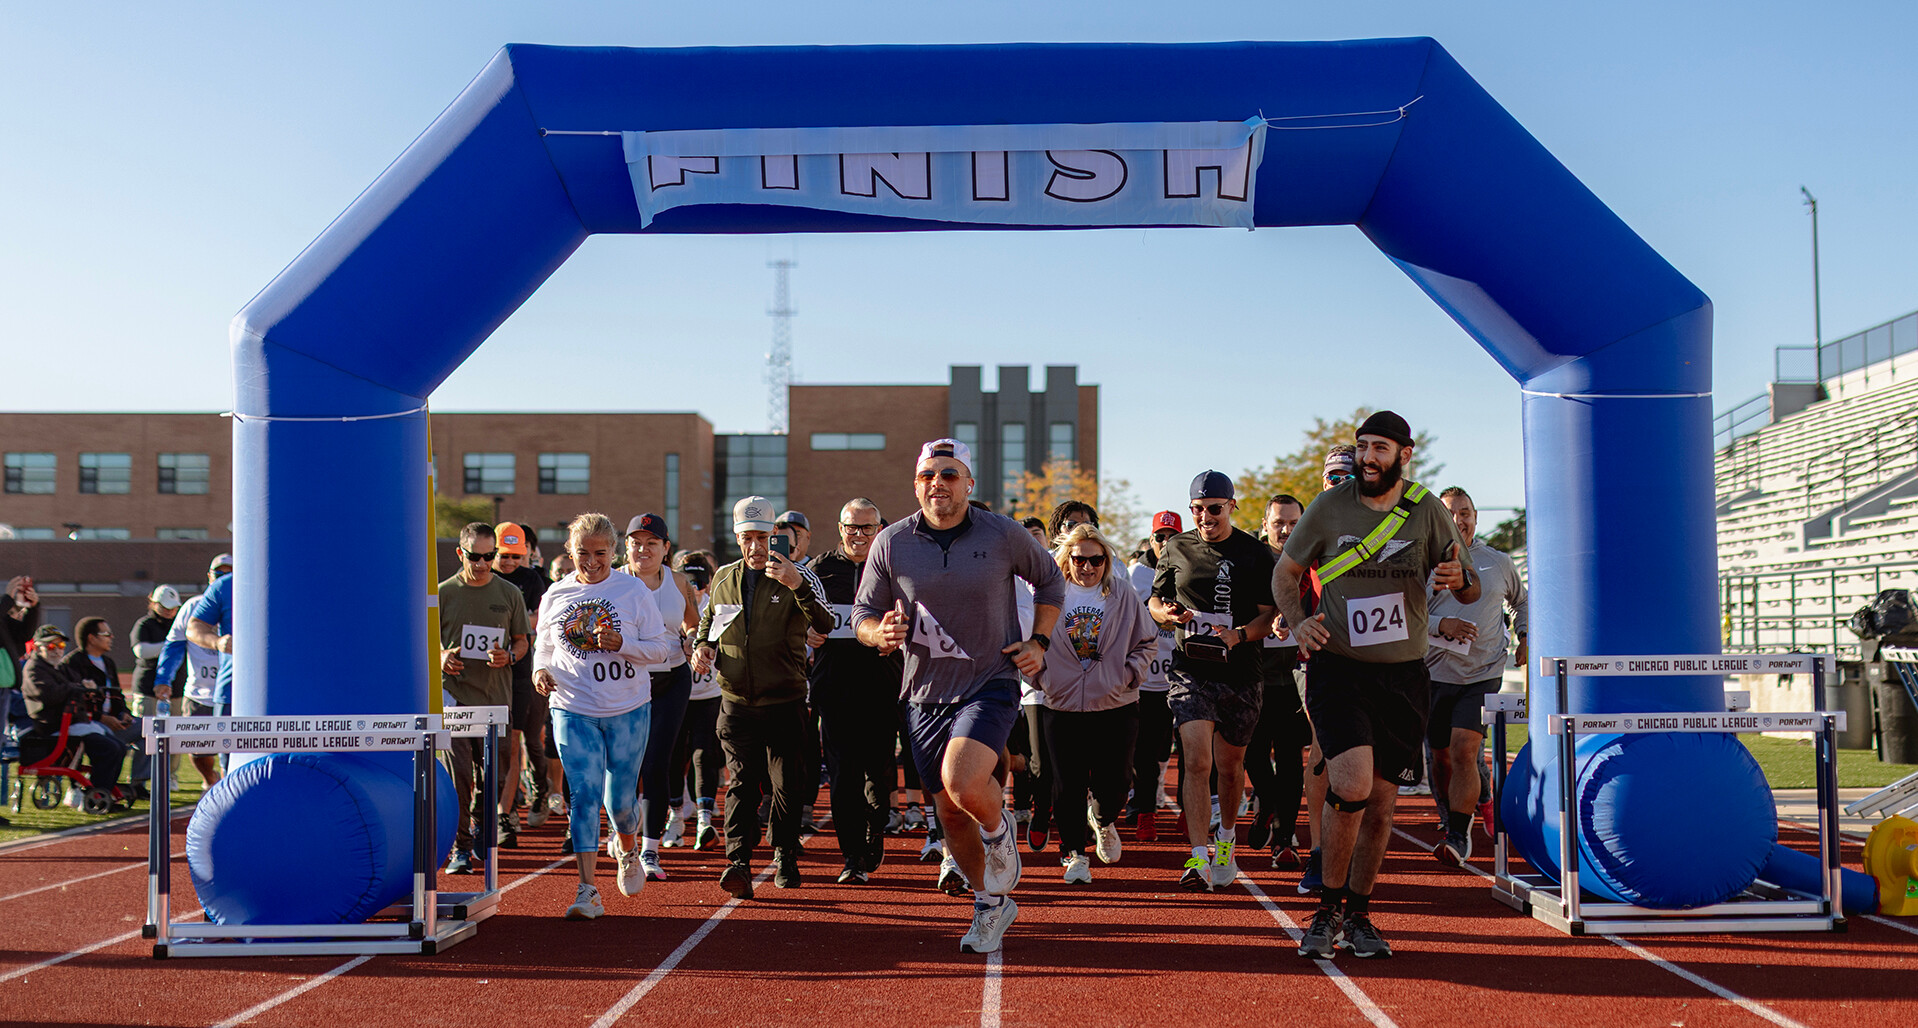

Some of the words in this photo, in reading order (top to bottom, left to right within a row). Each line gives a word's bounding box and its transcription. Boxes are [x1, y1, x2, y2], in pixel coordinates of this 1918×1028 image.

[1342, 569, 1387, 579] ANBU
[1390, 569, 1418, 579] GYM
[1352, 604, 1404, 635] 024
[593, 660, 636, 682] 008
[1628, 660, 1668, 672] CHICAGO
[1673, 660, 1708, 671] PUBLIC
[1712, 659, 1748, 671] LEAGUE
[230, 721, 272, 732] CHICAGO
[276, 721, 311, 731] PUBLIC
[315, 720, 352, 731] LEAGUE
[1637, 718, 1678, 729] CHICAGO
[1683, 717, 1717, 729] PUBLIC
[1722, 717, 1759, 728] LEAGUE
[236, 737, 278, 749] CHICAGO
[283, 736, 318, 748] PUBLIC
[322, 736, 360, 748] LEAGUE
